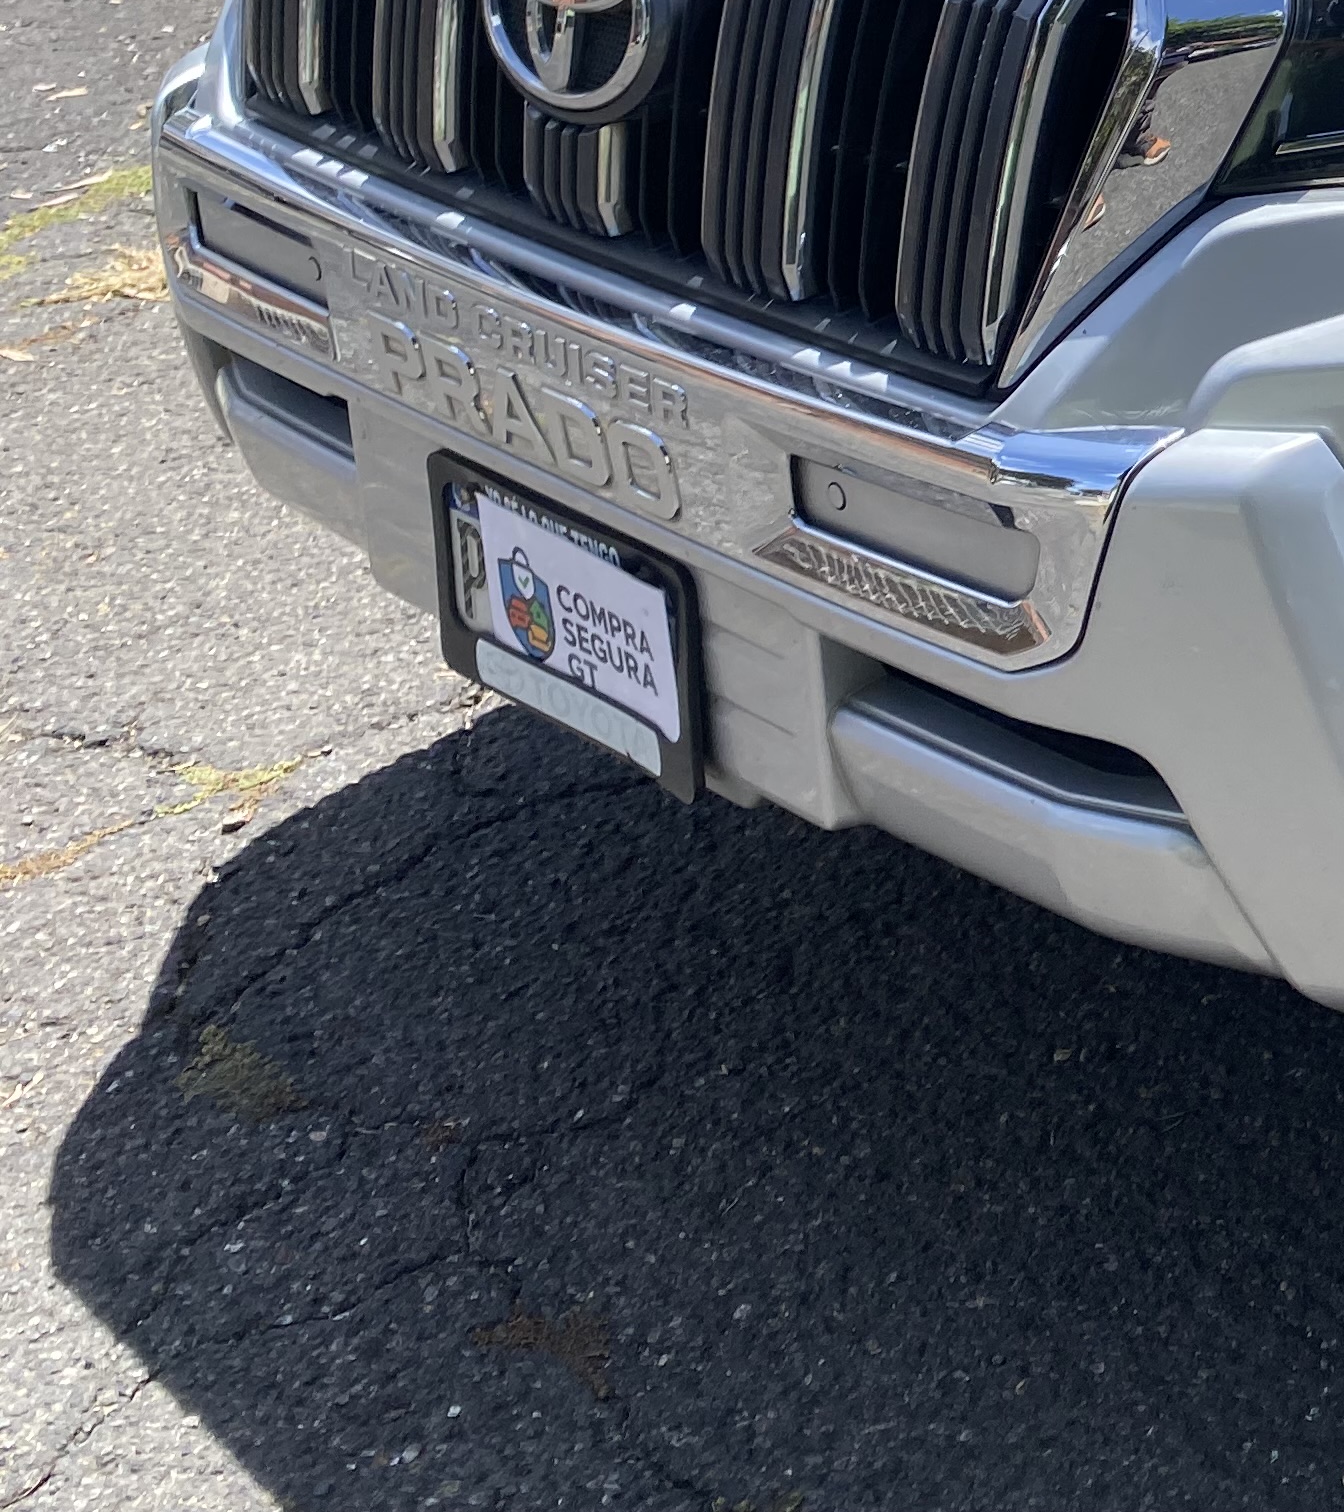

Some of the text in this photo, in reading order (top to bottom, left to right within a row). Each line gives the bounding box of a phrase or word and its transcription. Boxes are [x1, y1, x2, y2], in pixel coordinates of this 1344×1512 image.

[352, 246, 690, 430] LAND CRUISER
[368, 310, 683, 521] PRADO
[569, 529, 621, 568] TENGO
[556, 584, 655, 662] COMPRA
[561, 617, 660, 697] SEGURA
[567, 653, 599, 689] GT
[529, 672, 652, 752] TOYOTA
